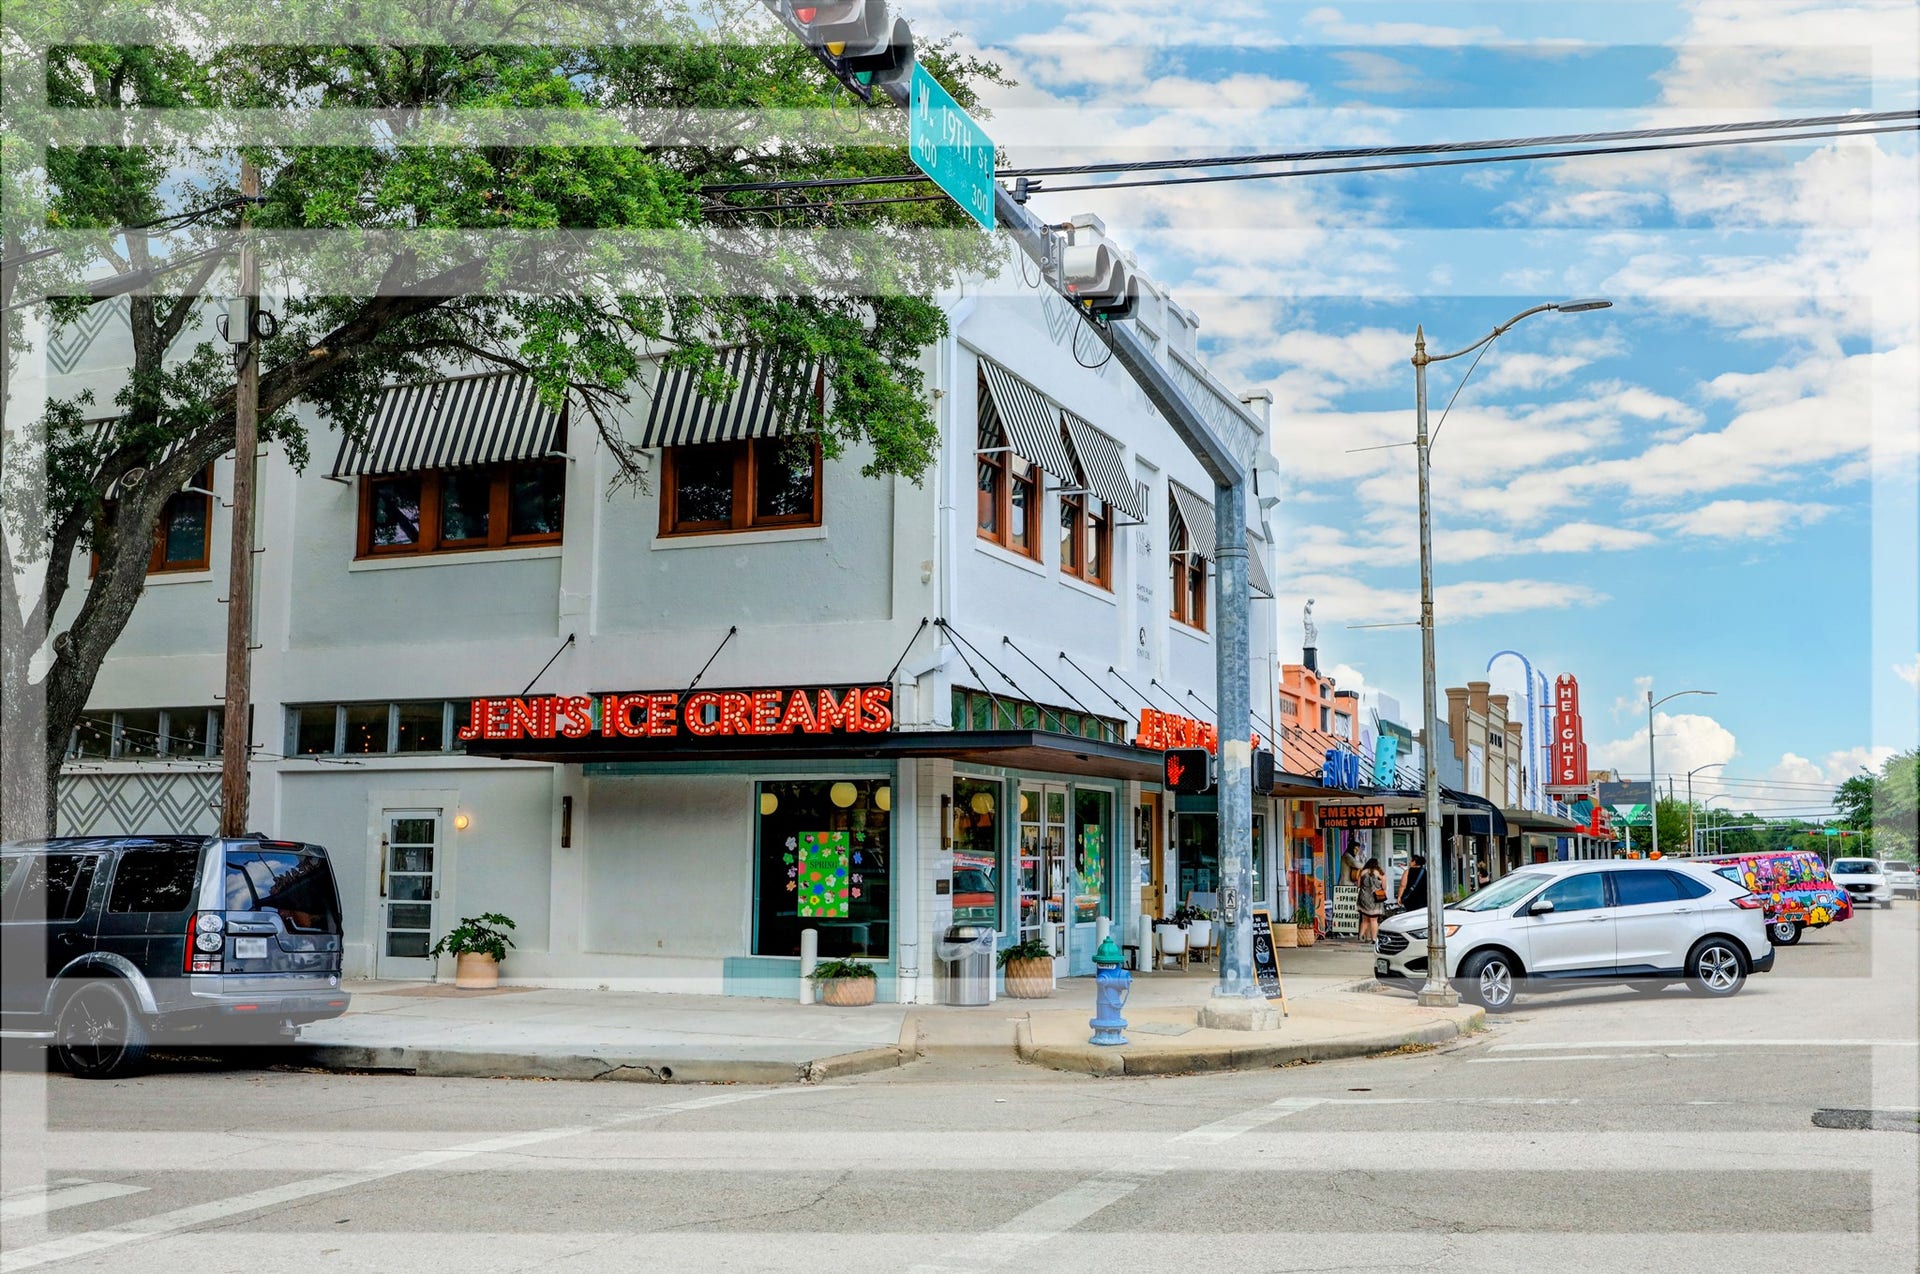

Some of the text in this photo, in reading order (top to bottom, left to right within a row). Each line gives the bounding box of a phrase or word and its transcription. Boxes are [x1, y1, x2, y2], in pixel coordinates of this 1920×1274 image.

[918, 134, 937, 168] 400
[943, 105, 972, 165] 19TH
[972, 184, 988, 216] 300
[458, 686, 892, 740] JENI'S ICE CREAMS
[1560, 687, 1574, 780] HEIGHTS
[1319, 805, 1383, 818] EMERSON
[1324, 818, 1348, 827] HOME
[1359, 817, 1378, 827] GIFT
[1390, 816, 1418, 827] HAIR
[809, 860, 838, 869] SPRING
